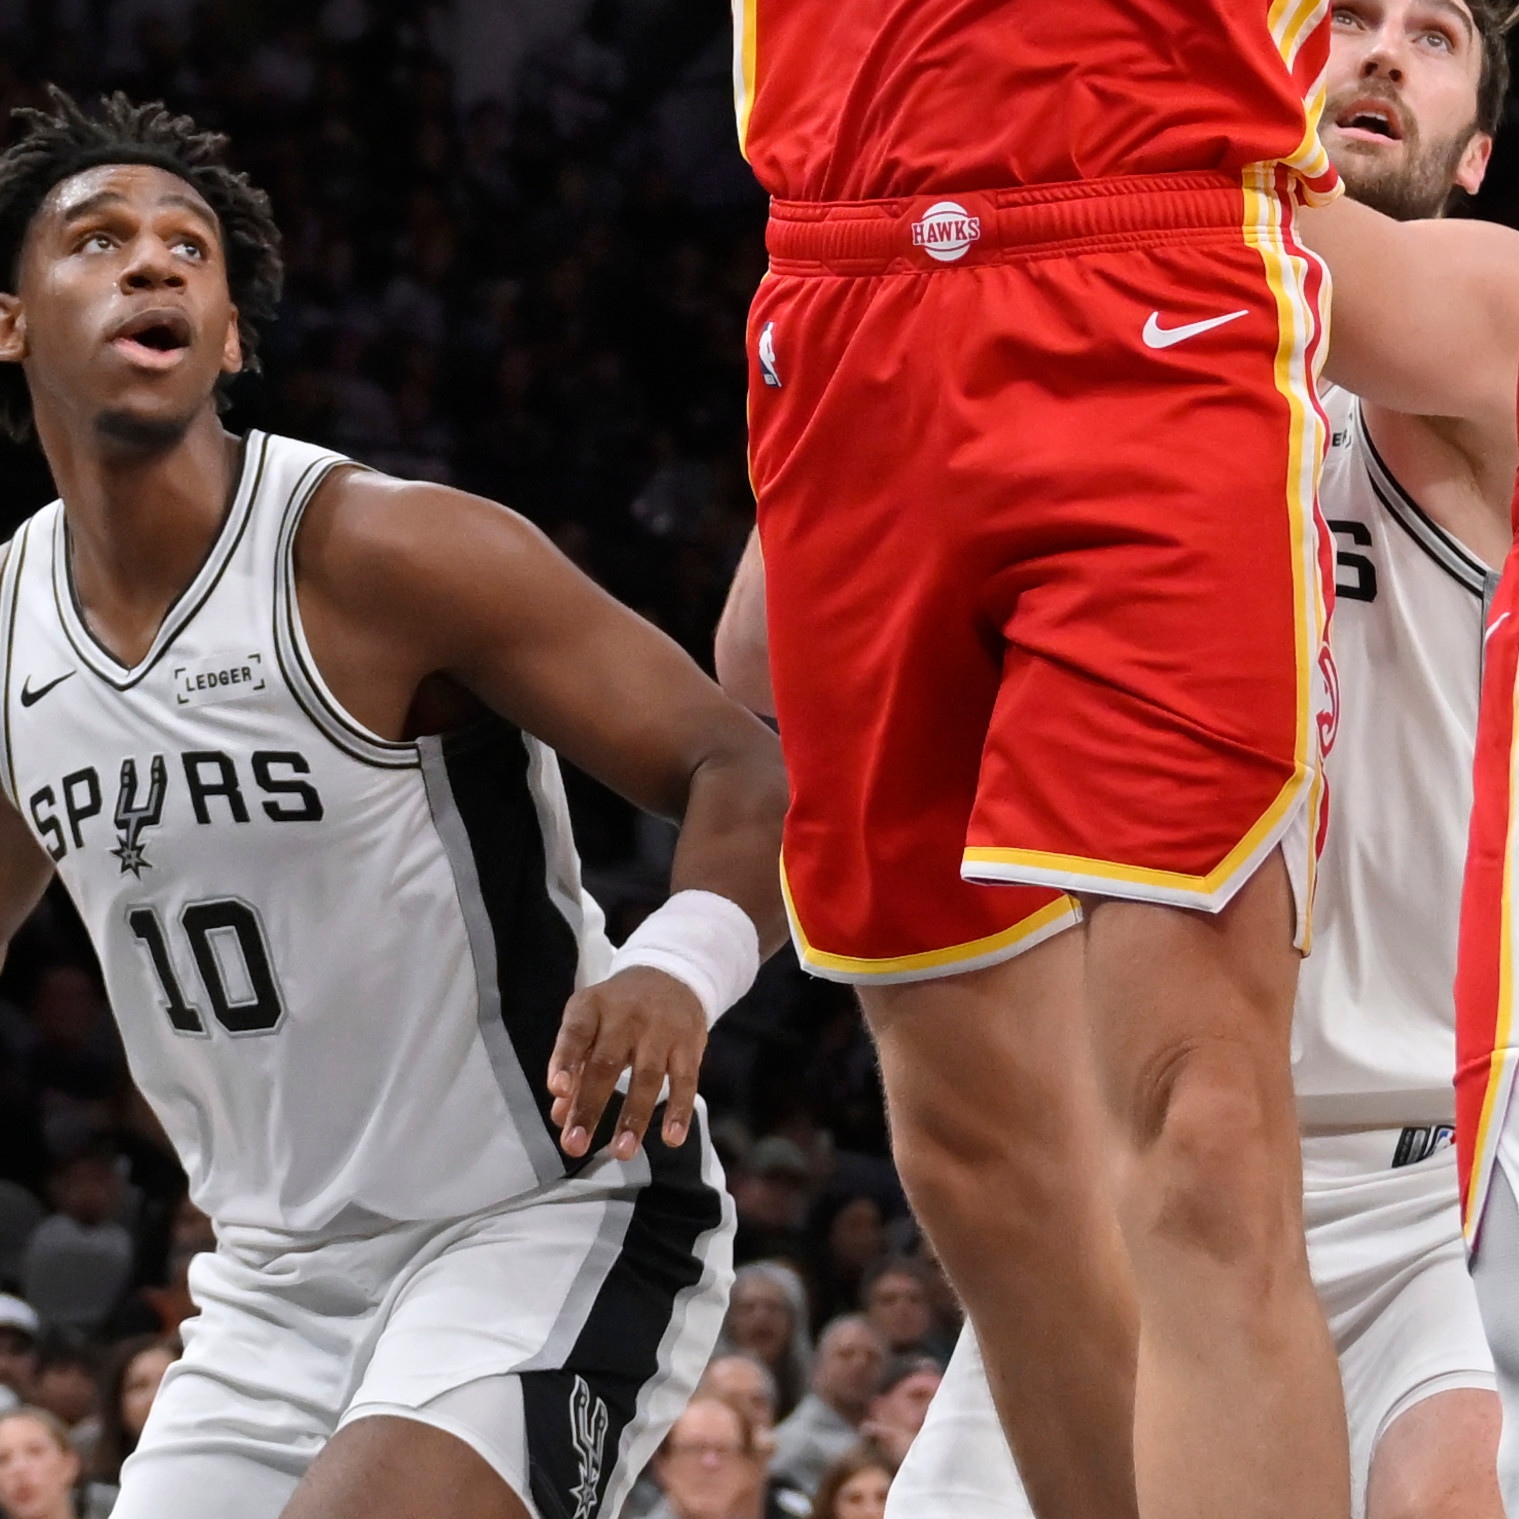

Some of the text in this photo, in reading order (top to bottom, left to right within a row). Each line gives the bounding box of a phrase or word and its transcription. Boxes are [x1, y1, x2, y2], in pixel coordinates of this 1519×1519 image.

[912, 217, 980, 245] HAWKS
[186, 666, 252, 692] LEDGER
[30, 750, 325, 880] SPURS
[125, 895, 288, 1040] 10
